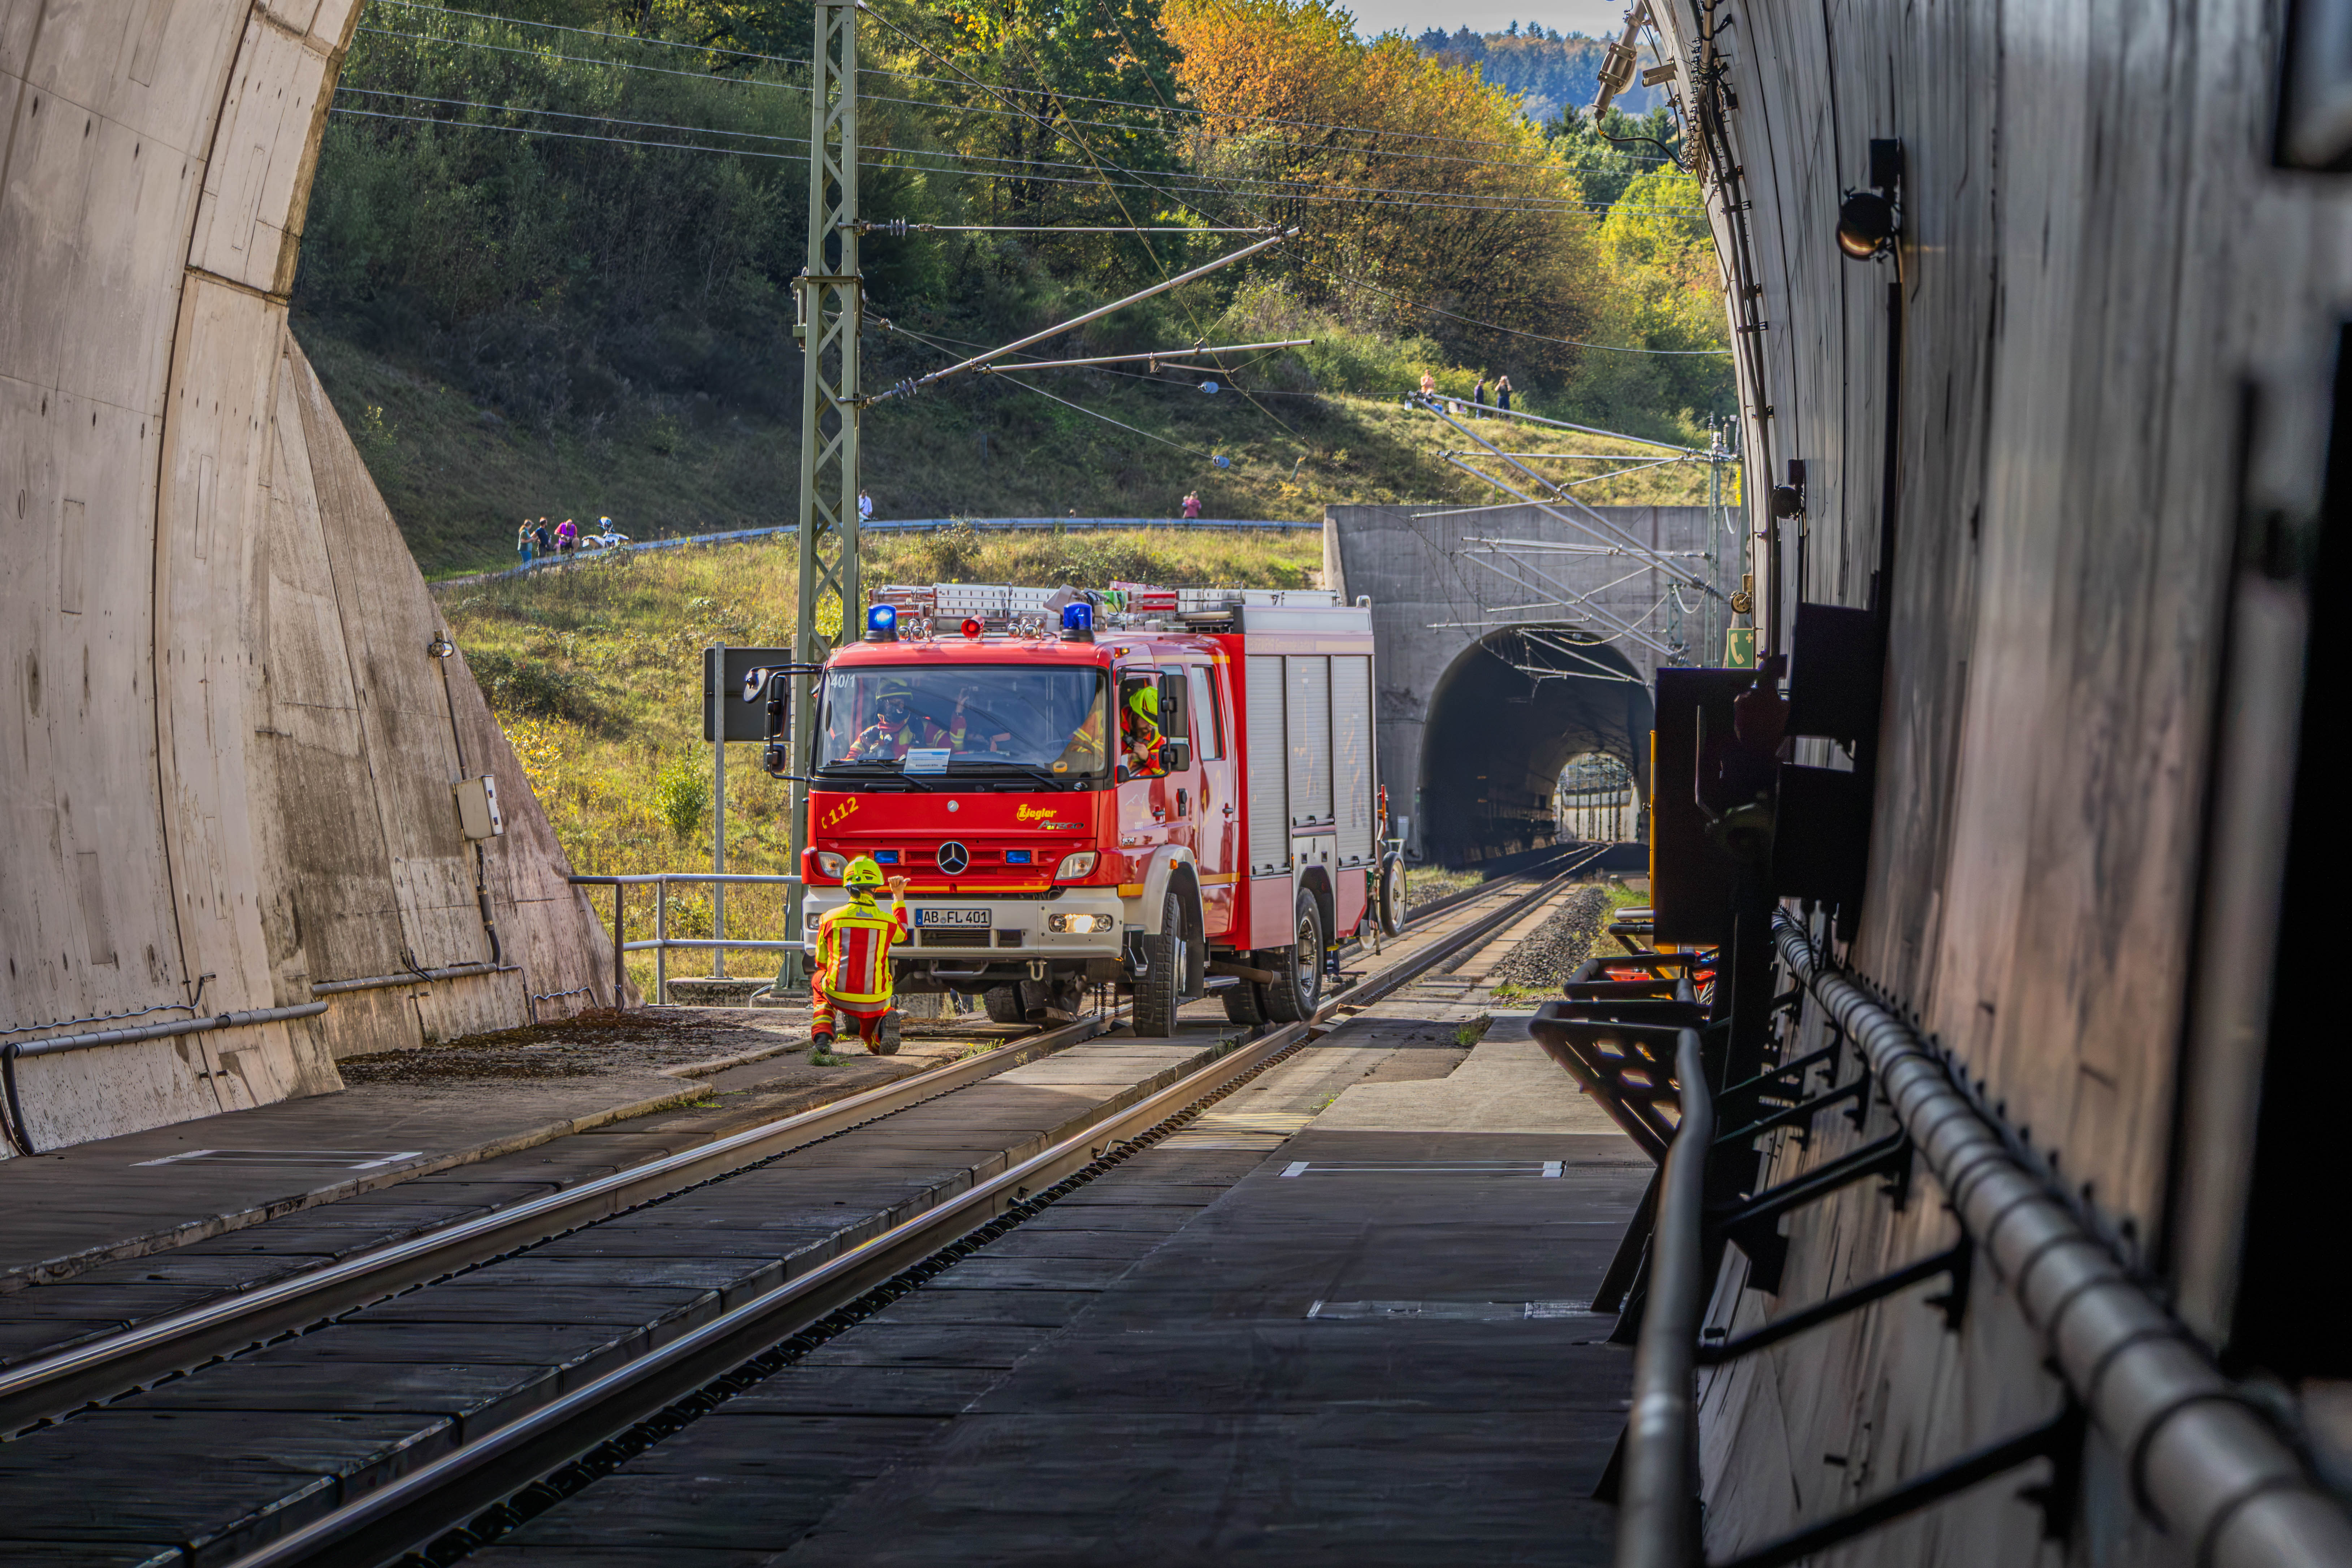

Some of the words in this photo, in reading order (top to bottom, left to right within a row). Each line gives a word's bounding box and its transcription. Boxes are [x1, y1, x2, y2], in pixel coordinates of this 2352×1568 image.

[831, 674, 855, 688] 40/1
[829, 796, 859, 825] 112
[1017, 804, 1057, 821] Ziegler
[923, 911, 939, 923] AB
[947, 911, 963, 923] FL
[966, 911, 988, 923] 401
